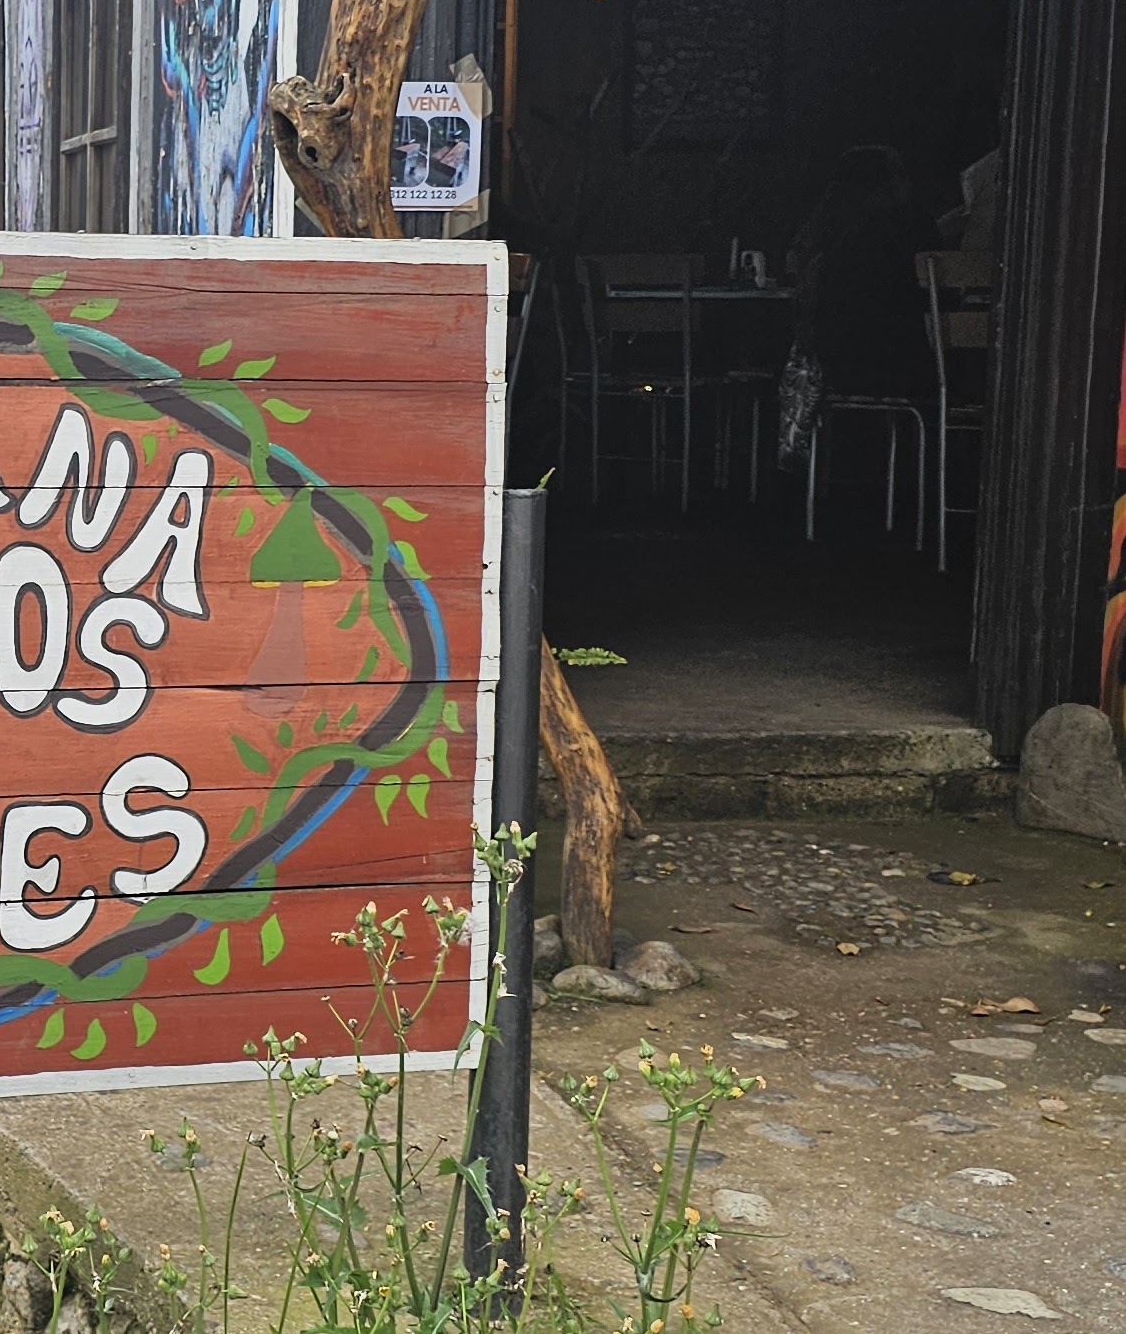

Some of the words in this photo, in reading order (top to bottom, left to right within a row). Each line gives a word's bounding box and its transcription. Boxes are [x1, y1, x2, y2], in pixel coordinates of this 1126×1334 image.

[424, 84, 432, 94] A
[434, 84, 448, 94] LA
[408, 97, 461, 112] VENTA
[410, 190, 427, 199] 122
[431, 190, 442, 199] 12
[445, 190, 457, 199] 28
